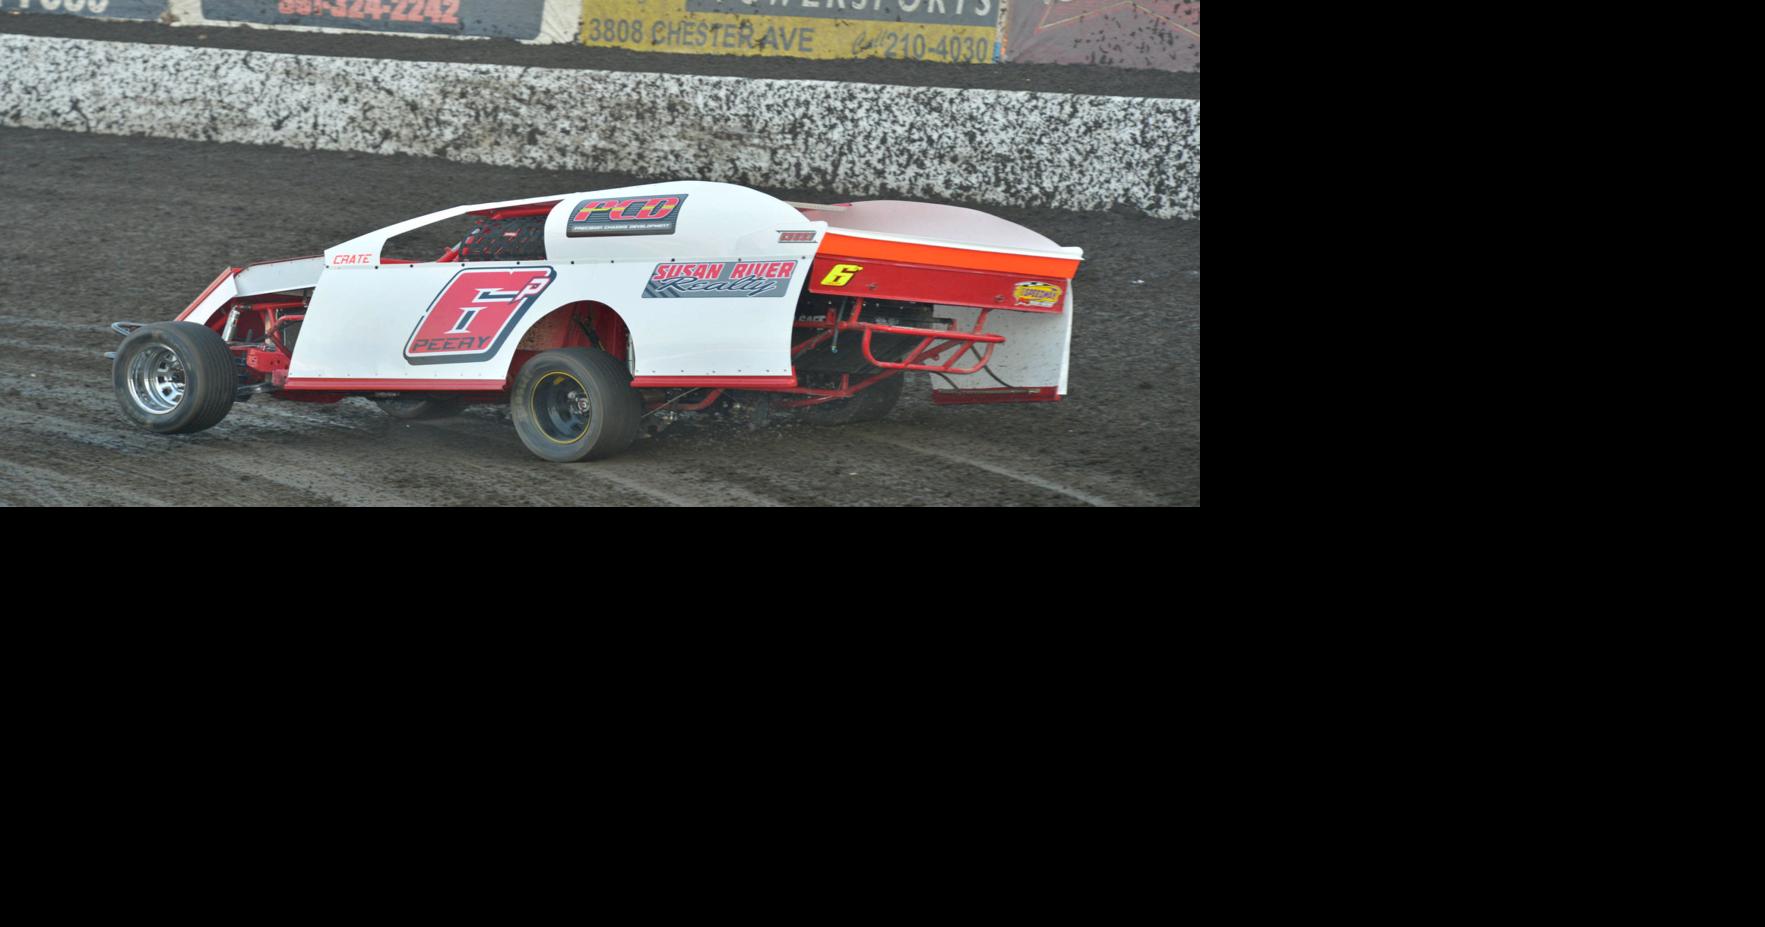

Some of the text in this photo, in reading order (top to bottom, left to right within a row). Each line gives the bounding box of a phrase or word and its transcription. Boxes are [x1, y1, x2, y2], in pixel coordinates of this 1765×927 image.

[589, 18, 815, 52] 3808 CHESTER AVE
[885, 32, 987, 63] 210-4030
[574, 197, 680, 221] PCD
[333, 253, 372, 264] CRATE
[653, 261, 796, 280] SUSAN RIVER
[657, 275, 776, 297] Realty
[412, 336, 492, 351] PEERY
